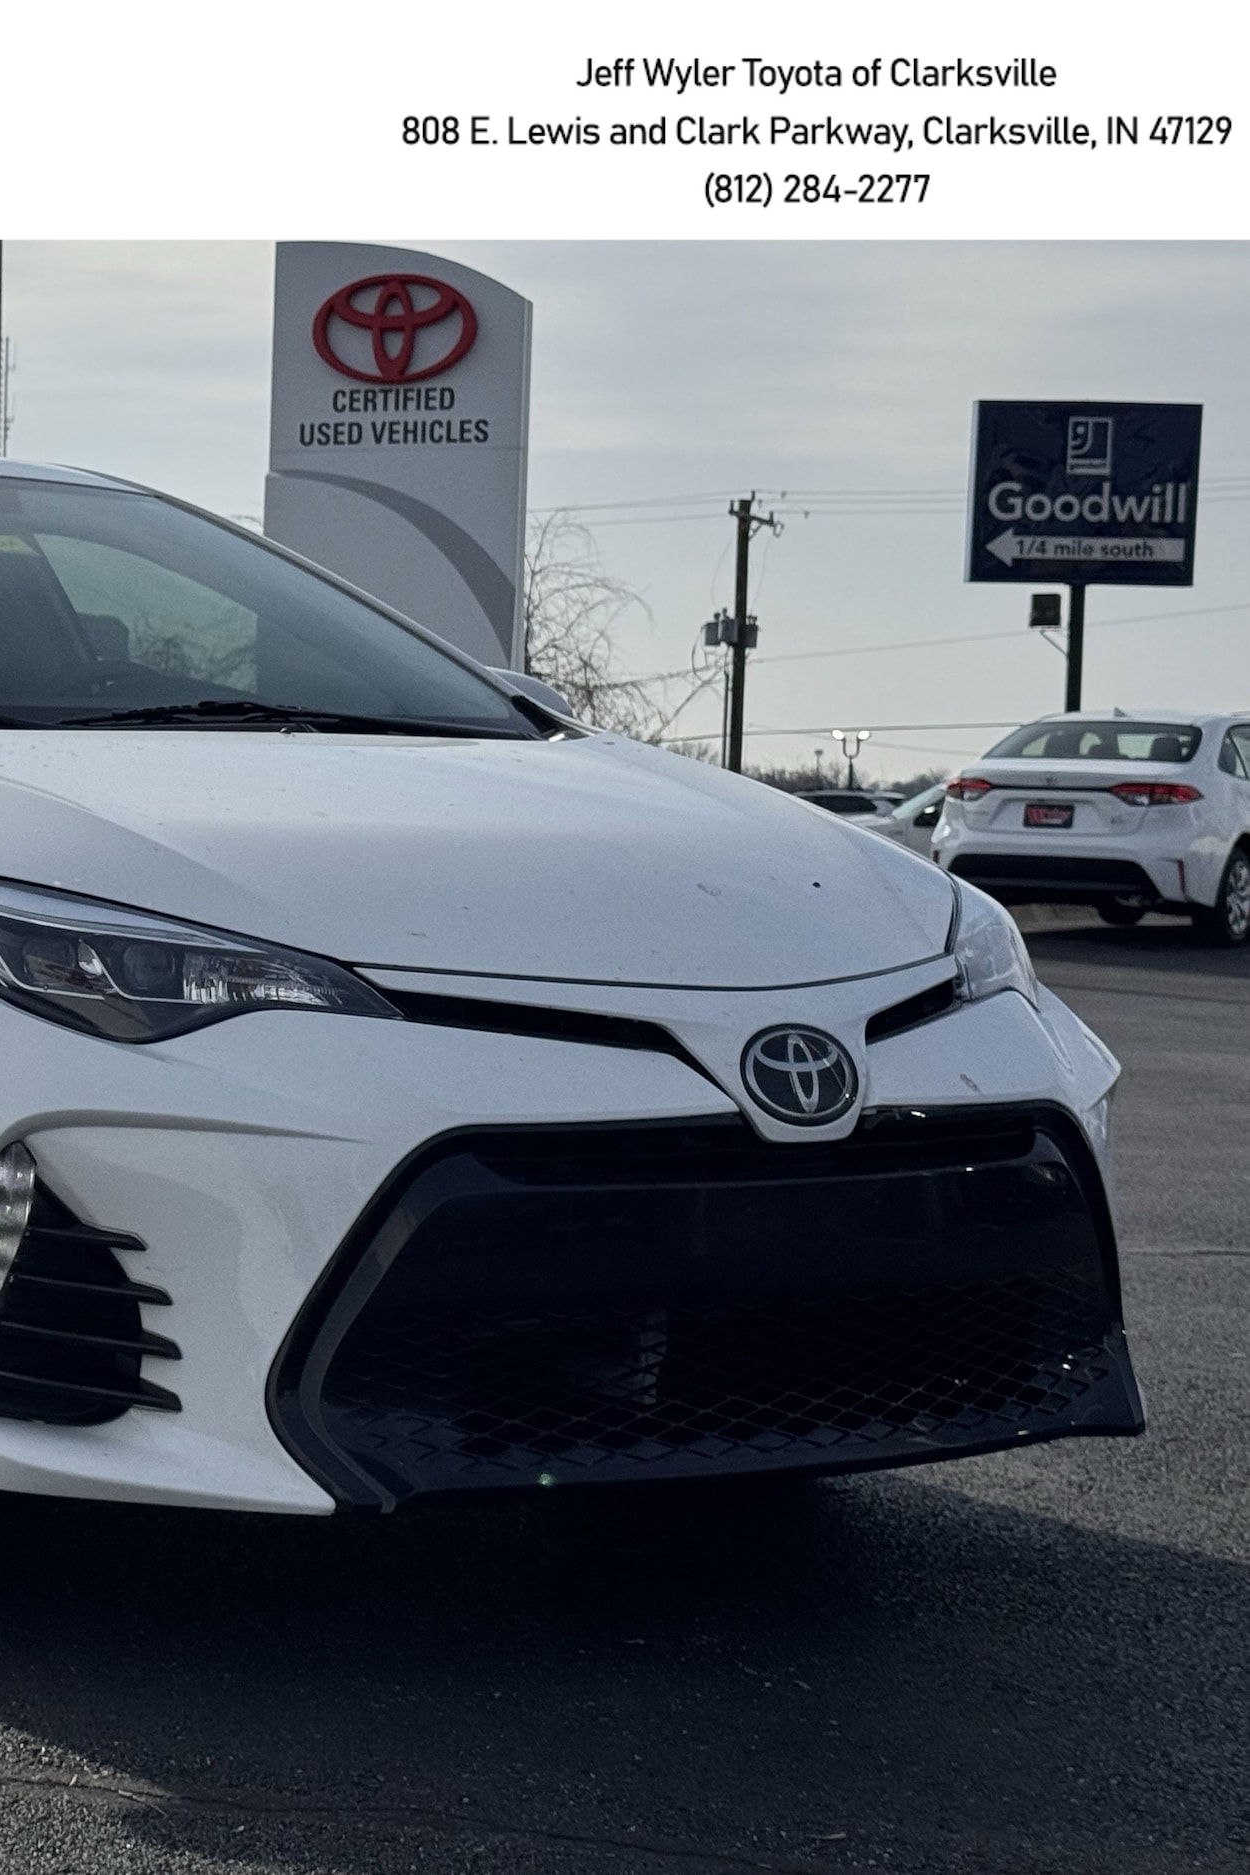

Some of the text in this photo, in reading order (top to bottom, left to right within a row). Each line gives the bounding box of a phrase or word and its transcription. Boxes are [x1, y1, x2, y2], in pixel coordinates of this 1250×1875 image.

[332, 387, 455, 413] CERTIFIED
[299, 419, 490, 447] USED VEHICLES
[988, 481, 1187, 524] Goodwill
[1016, 539, 1154, 558] 1/4 mile south
